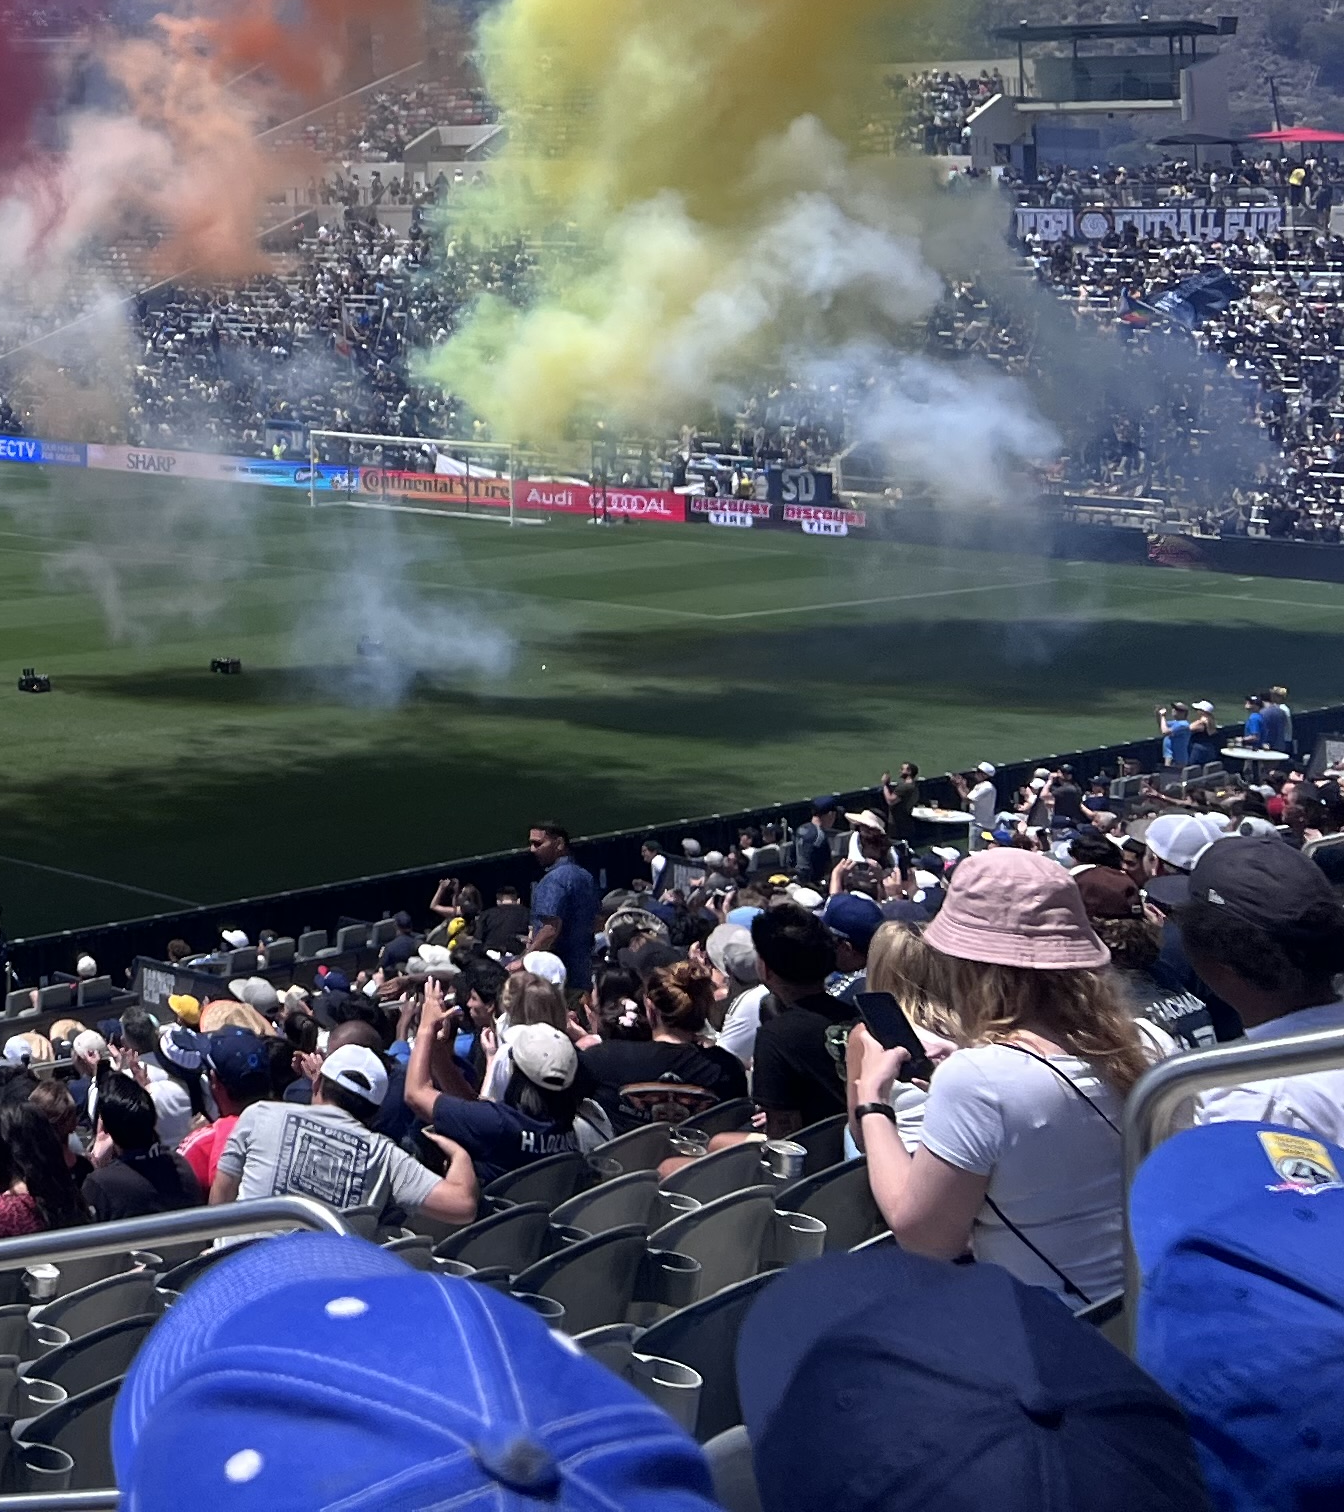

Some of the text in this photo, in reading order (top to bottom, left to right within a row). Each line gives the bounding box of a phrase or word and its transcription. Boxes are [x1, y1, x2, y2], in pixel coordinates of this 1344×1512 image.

[126, 452, 176, 473] SHARP
[362, 470, 455, 495] Continental
[472, 476, 511, 498] Tire
[781, 468, 817, 502] SD
[527, 488, 573, 507] Audi
[713, 514, 747, 527] TIRE
[808, 521, 843, 534] TIRE
[1146, 991, 1206, 1021] MACHAD
